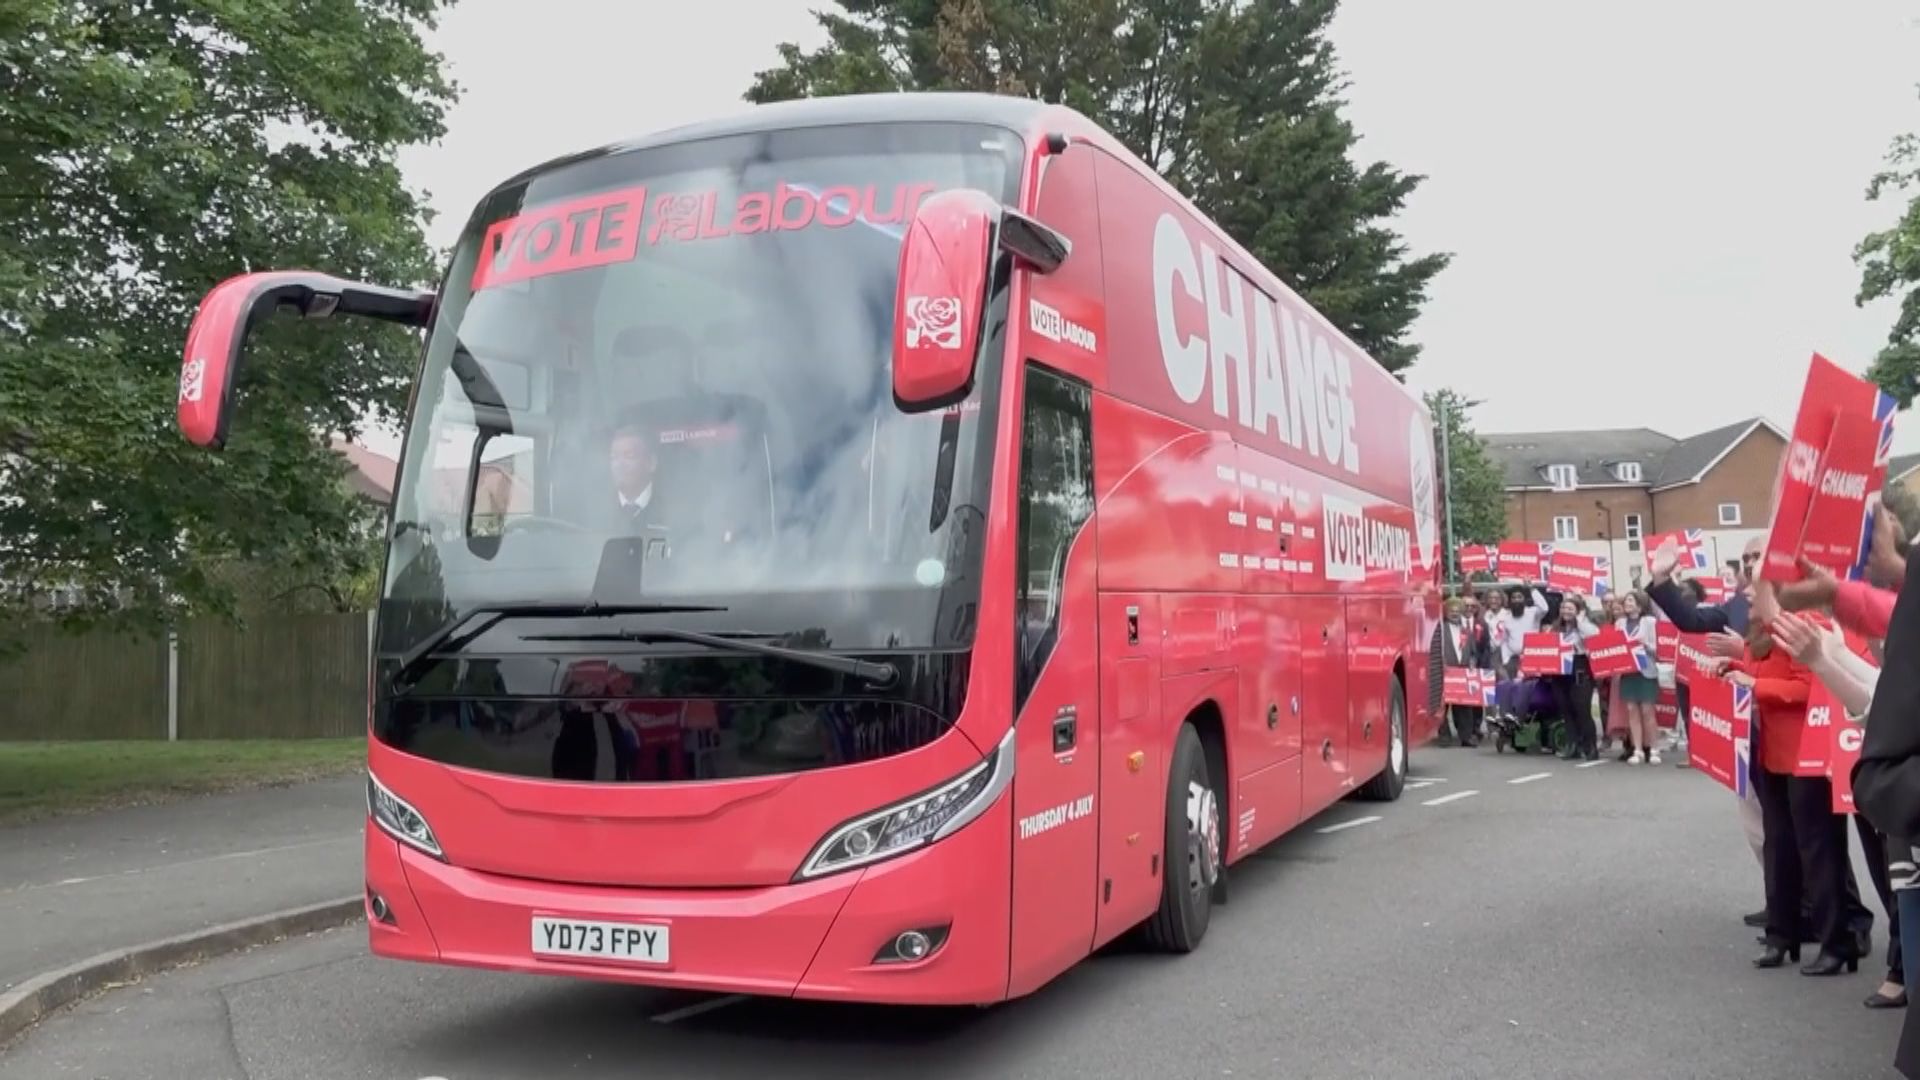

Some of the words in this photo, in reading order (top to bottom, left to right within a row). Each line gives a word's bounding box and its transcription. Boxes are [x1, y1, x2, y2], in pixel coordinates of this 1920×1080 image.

[493, 202, 630, 273] VOTE
[1032, 303, 1059, 337] VOTE
[1061, 318, 1096, 353] LABOUR
[1153, 213, 1359, 474] CHANGE
[1821, 468, 1867, 500] CHANGE
[1326, 506, 1362, 567] VOTE
[1364, 517, 1406, 571] LABOUR
[1691, 706, 1732, 741] CHANGE
[1807, 705, 1831, 727] CH
[1019, 803, 1068, 840] THURSDAY
[1068, 801, 1074, 821] 4
[1075, 794, 1094, 819] JULY
[544, 923, 603, 952] YD73
[611, 928, 657, 956] FPY
